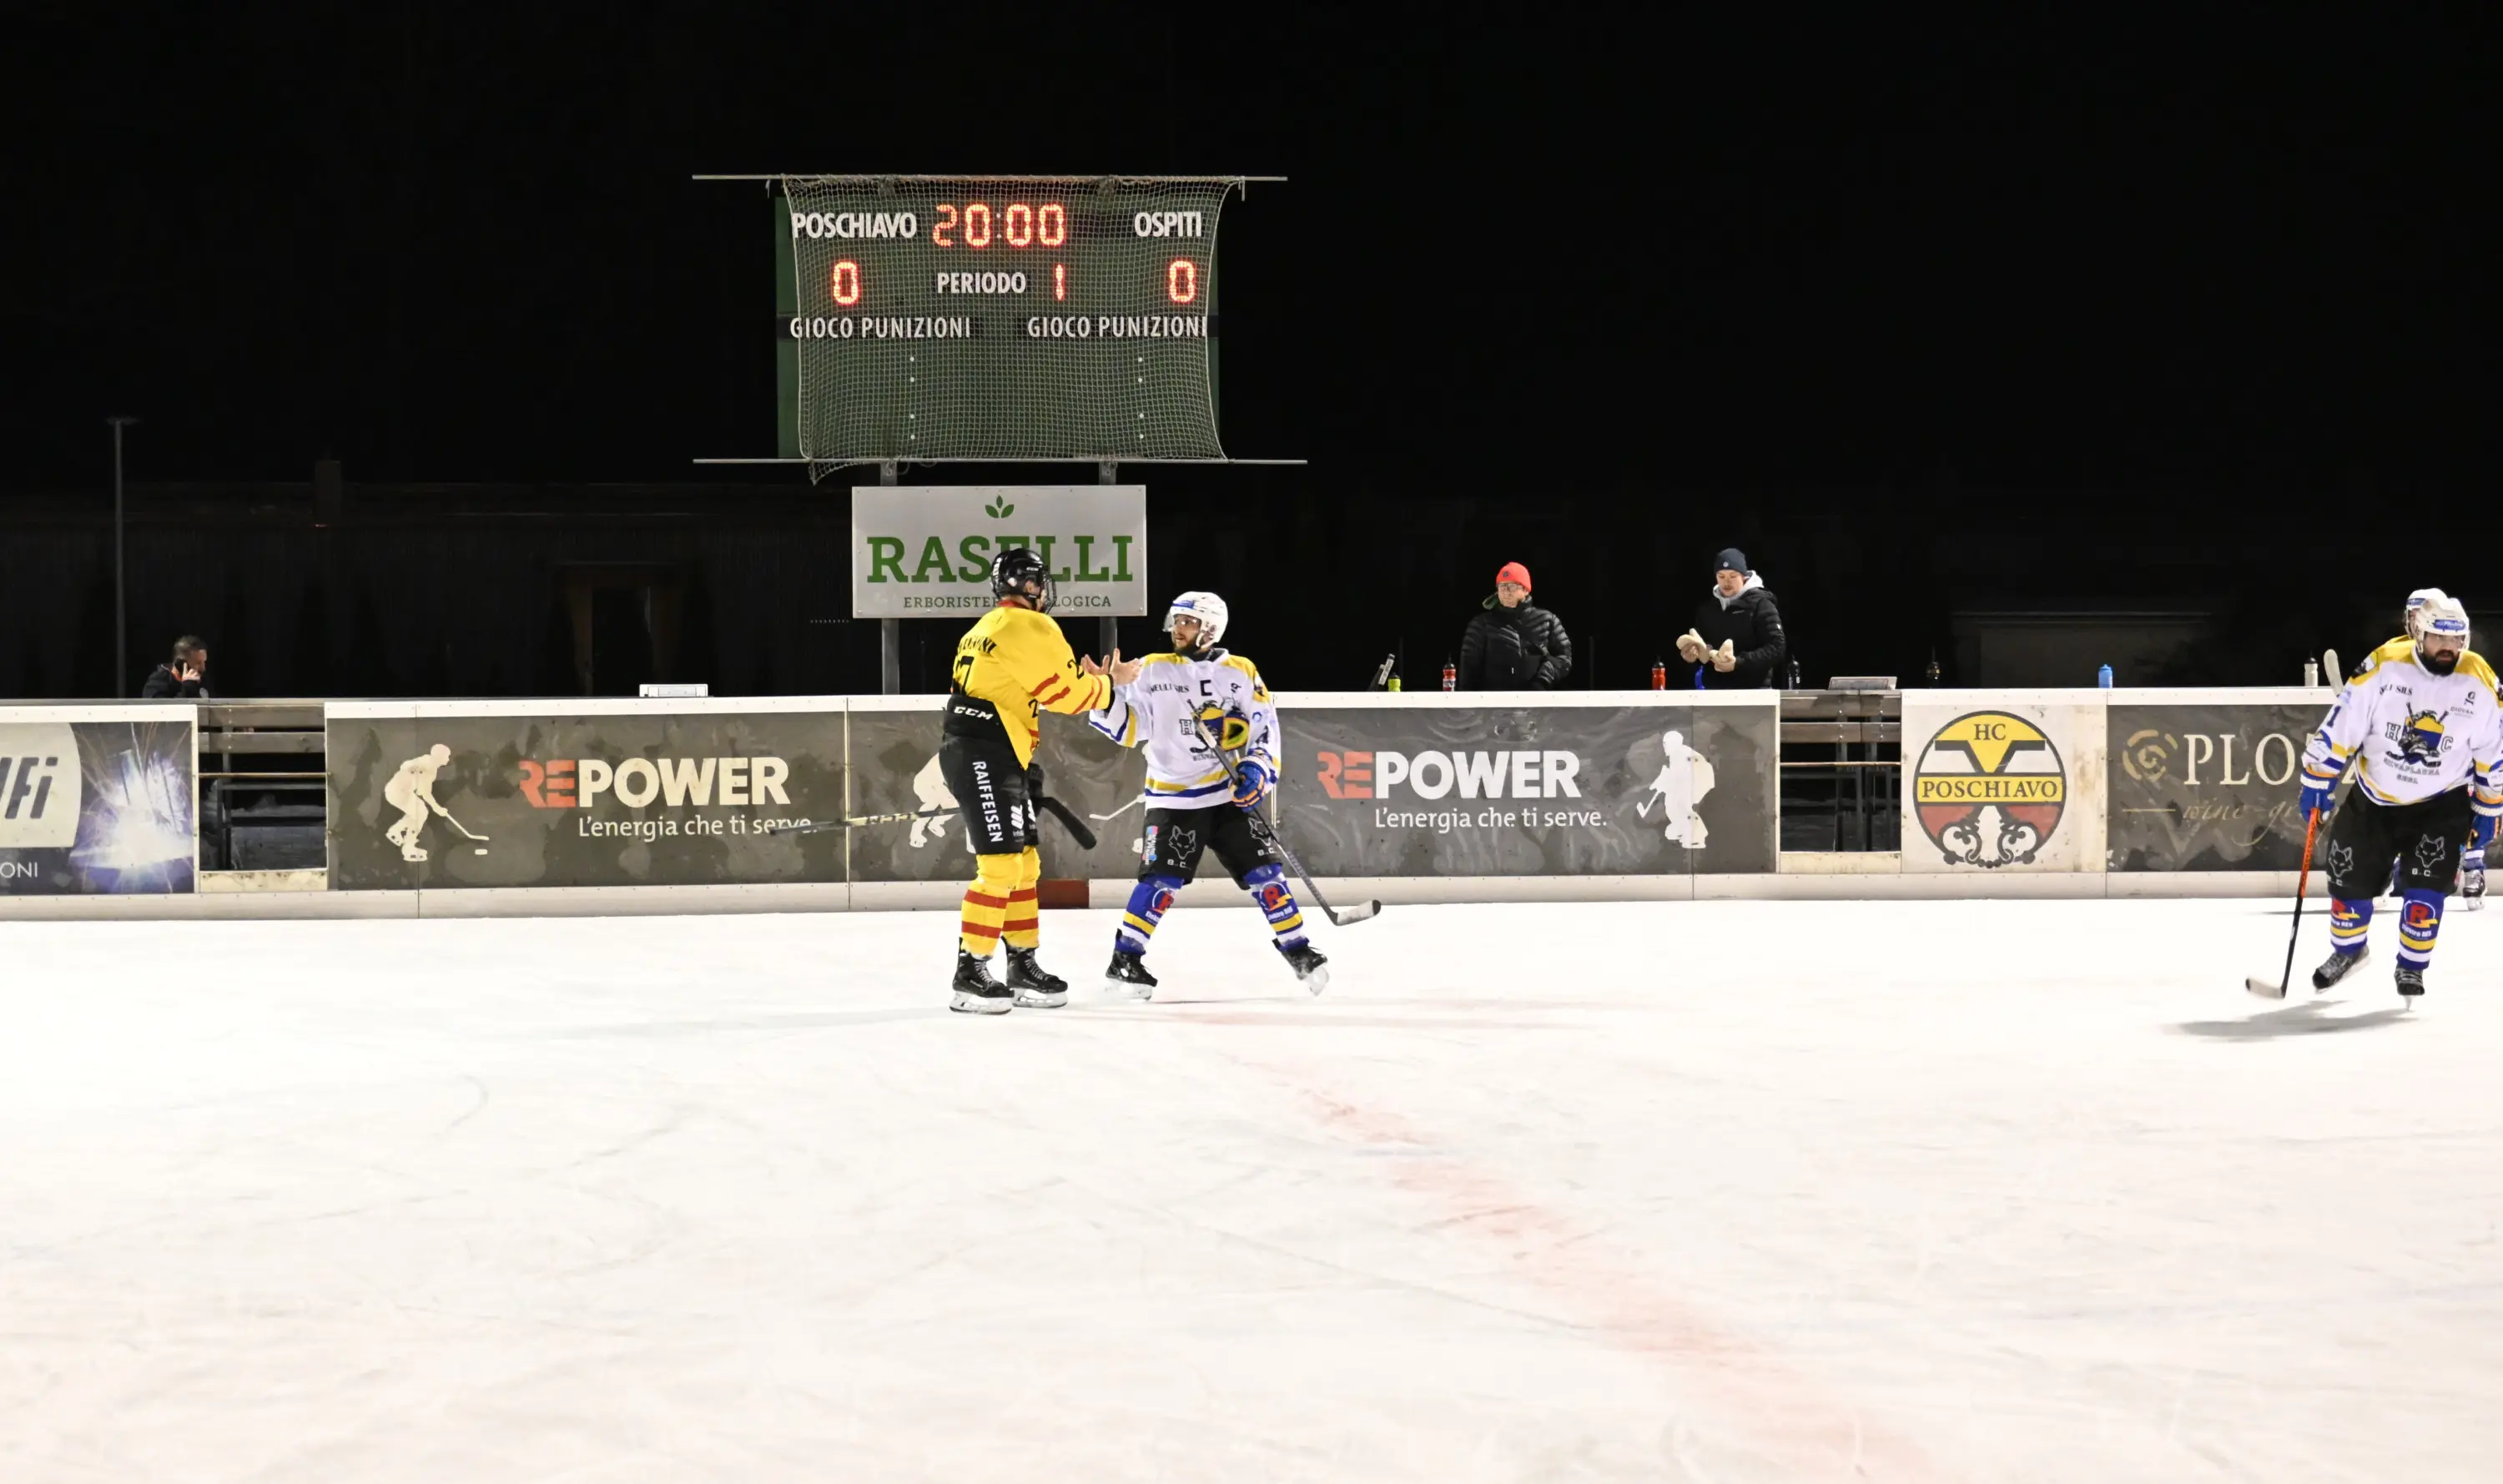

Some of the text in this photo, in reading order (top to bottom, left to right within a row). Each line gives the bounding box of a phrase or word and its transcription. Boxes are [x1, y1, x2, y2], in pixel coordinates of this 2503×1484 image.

[792, 212, 917, 239] POSCHIAVO
[933, 204, 1065, 248] 20:00
[1134, 211, 1202, 238] OSPITI
[833, 260, 859, 305] 0
[937, 272, 1026, 294] PERIODO
[1053, 263, 1065, 301] 1
[1168, 259, 1196, 304] 0
[790, 317, 970, 339] GIOCO PUNIZIONI
[1027, 315, 1207, 337] GIOCO PUNIZIONI
[1200, 679, 1212, 697] C
[954, 706, 994, 720] CCM
[1974, 722, 2007, 742] HC
[2385, 722, 2454, 752] H C
[519, 757, 791, 807] REPOWER
[1317, 751, 1582, 800] REPOWER
[972, 761, 1004, 843] RAIFFEISEN
[1921, 780, 2058, 800] POSCHIAVO
[579, 815, 678, 843] L'energia
[685, 815, 723, 835] che
[729, 814, 746, 835] ti
[1375, 807, 1607, 833] L'energia che ti serve.
